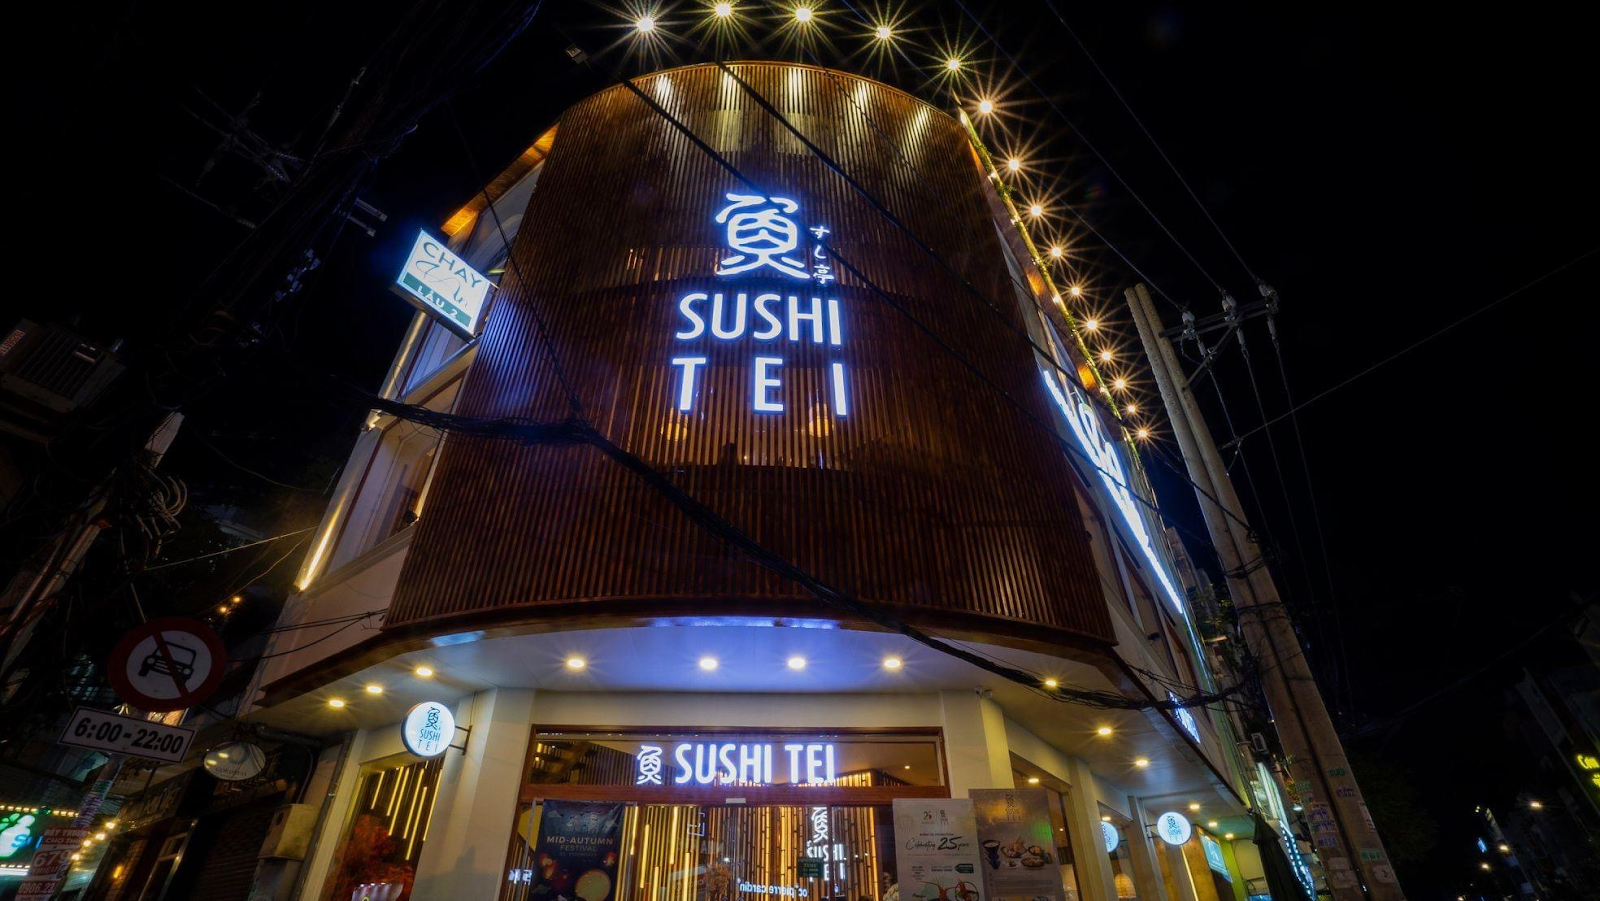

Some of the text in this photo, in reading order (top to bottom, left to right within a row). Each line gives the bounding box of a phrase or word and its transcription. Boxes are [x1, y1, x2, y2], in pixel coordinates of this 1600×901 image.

[423, 241, 482, 288] CHAY
[448, 308, 458, 319] 2
[676, 293, 842, 345] SUSHI
[420, 728, 441, 742] SUSHI
[675, 743, 835, 784] SUSHI TEI
[546, 836, 613, 845] MID-AUTUMN
[938, 835, 965, 850] 25
